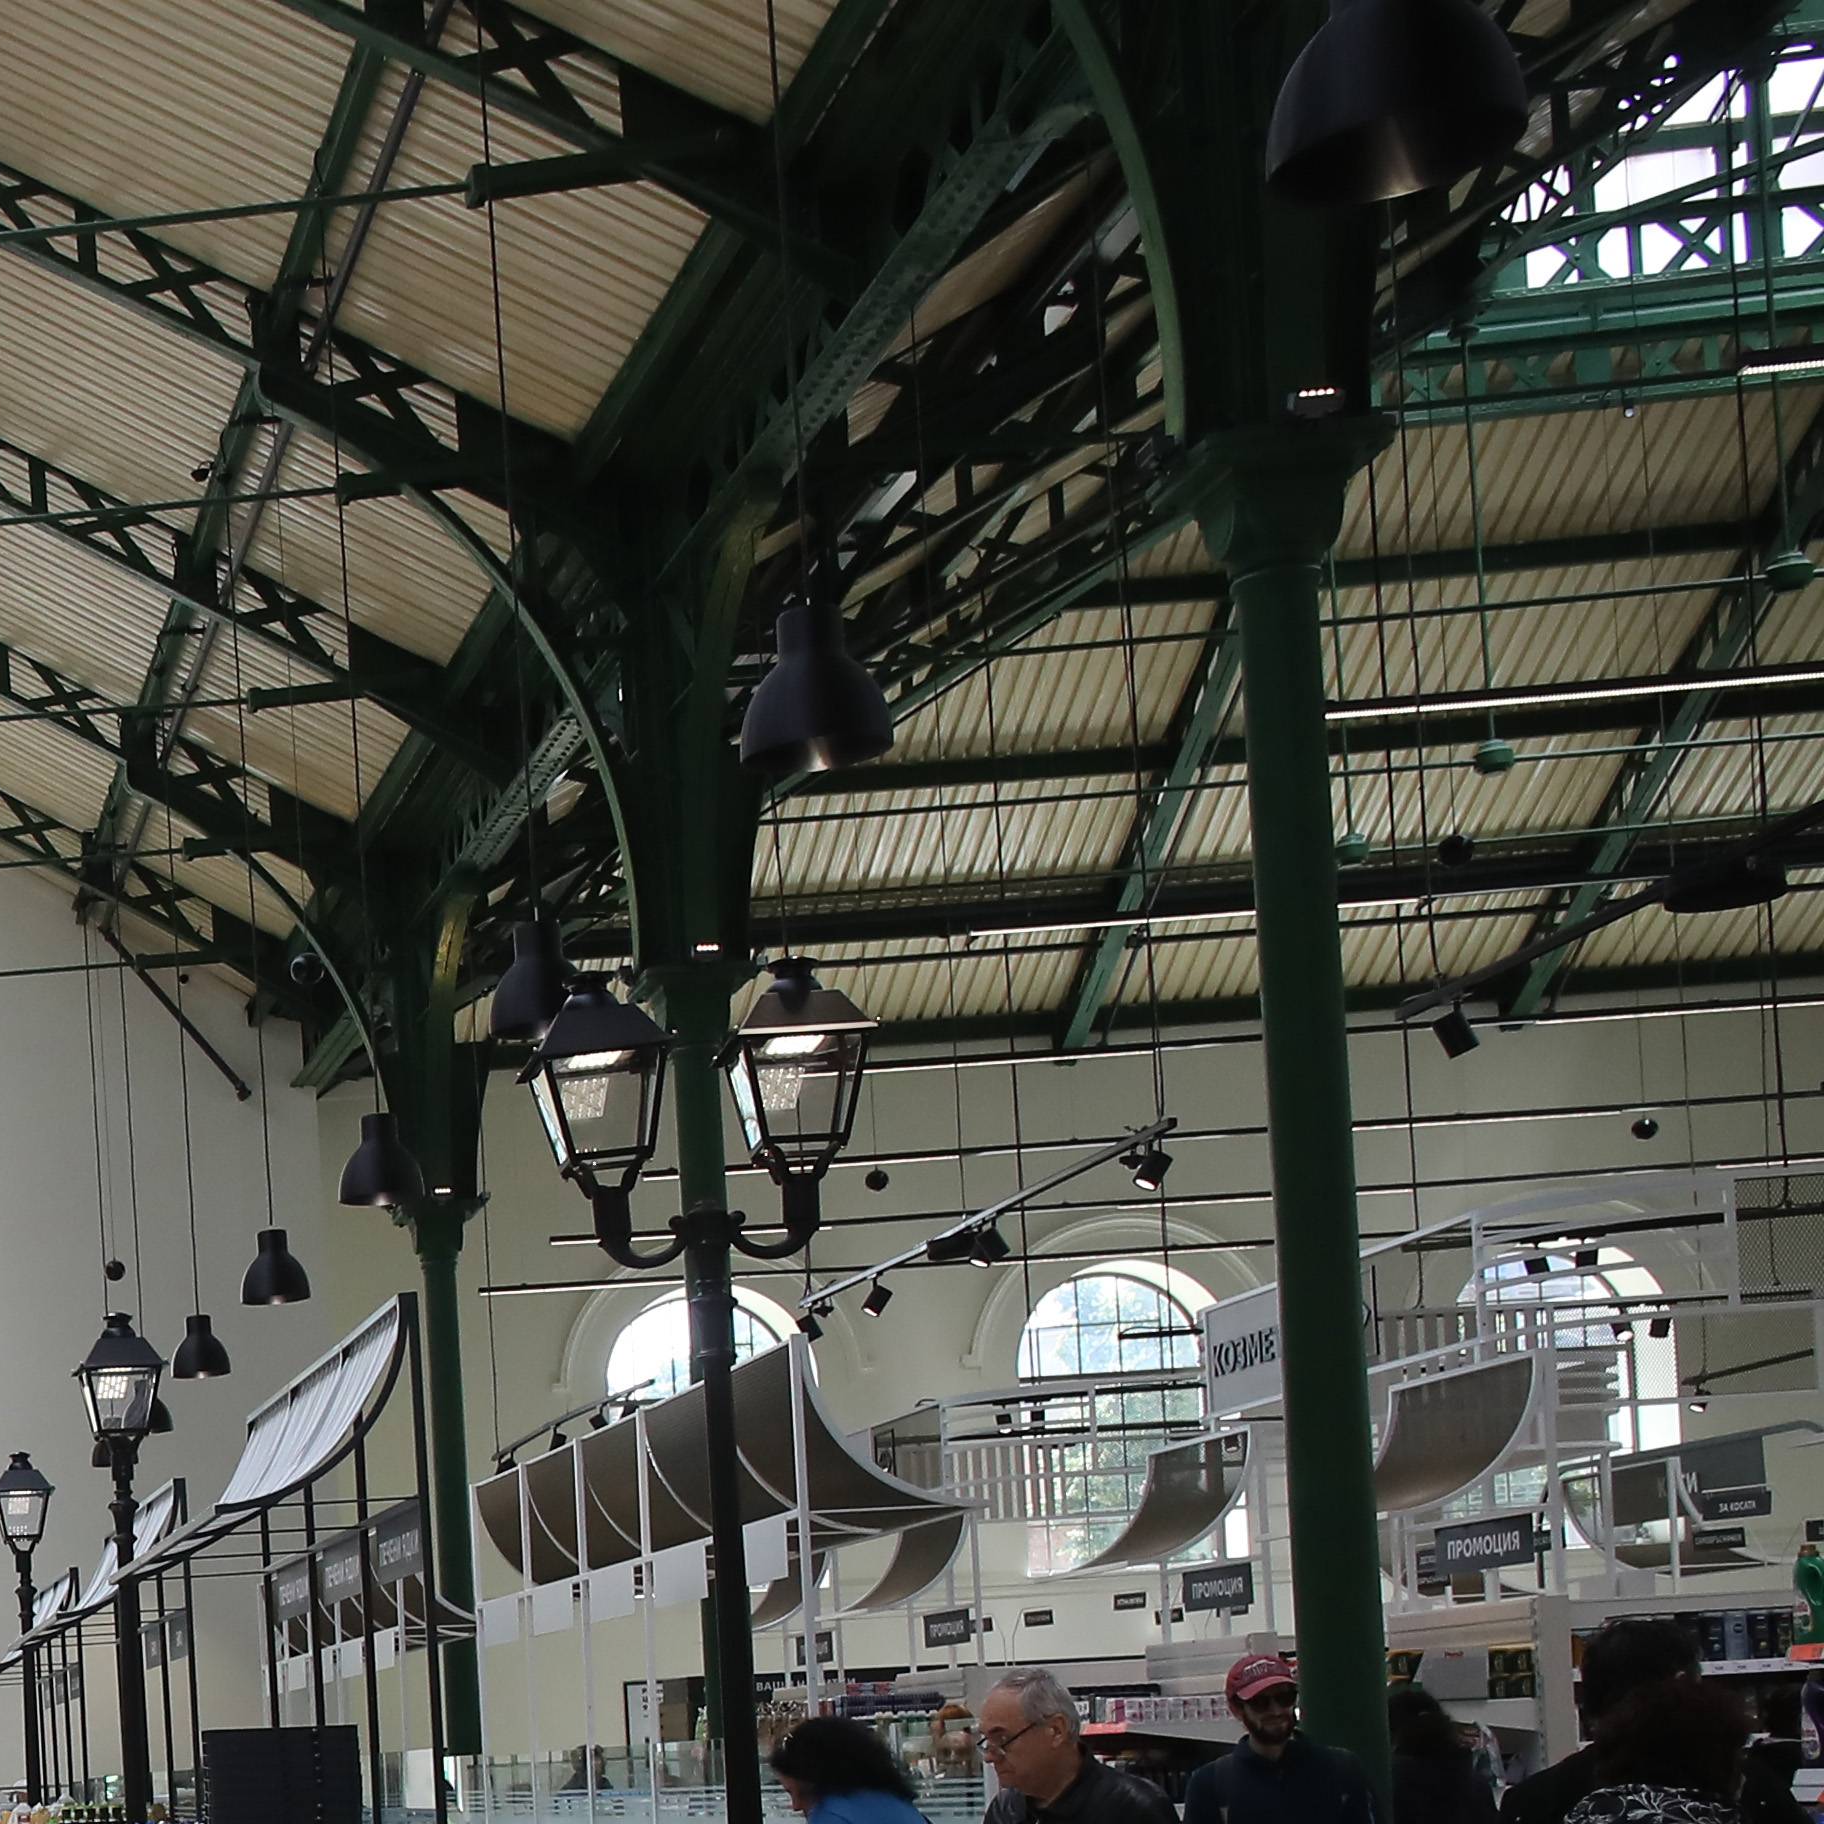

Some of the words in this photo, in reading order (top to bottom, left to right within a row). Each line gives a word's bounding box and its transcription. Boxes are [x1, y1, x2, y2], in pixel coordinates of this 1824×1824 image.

[1213, 1326, 1277, 1378] КОЗМЕ
[1447, 1530, 1521, 1560] ПРОМОЦИЯ
[1191, 1576, 1244, 1601] ПРОМОЦИЯ
